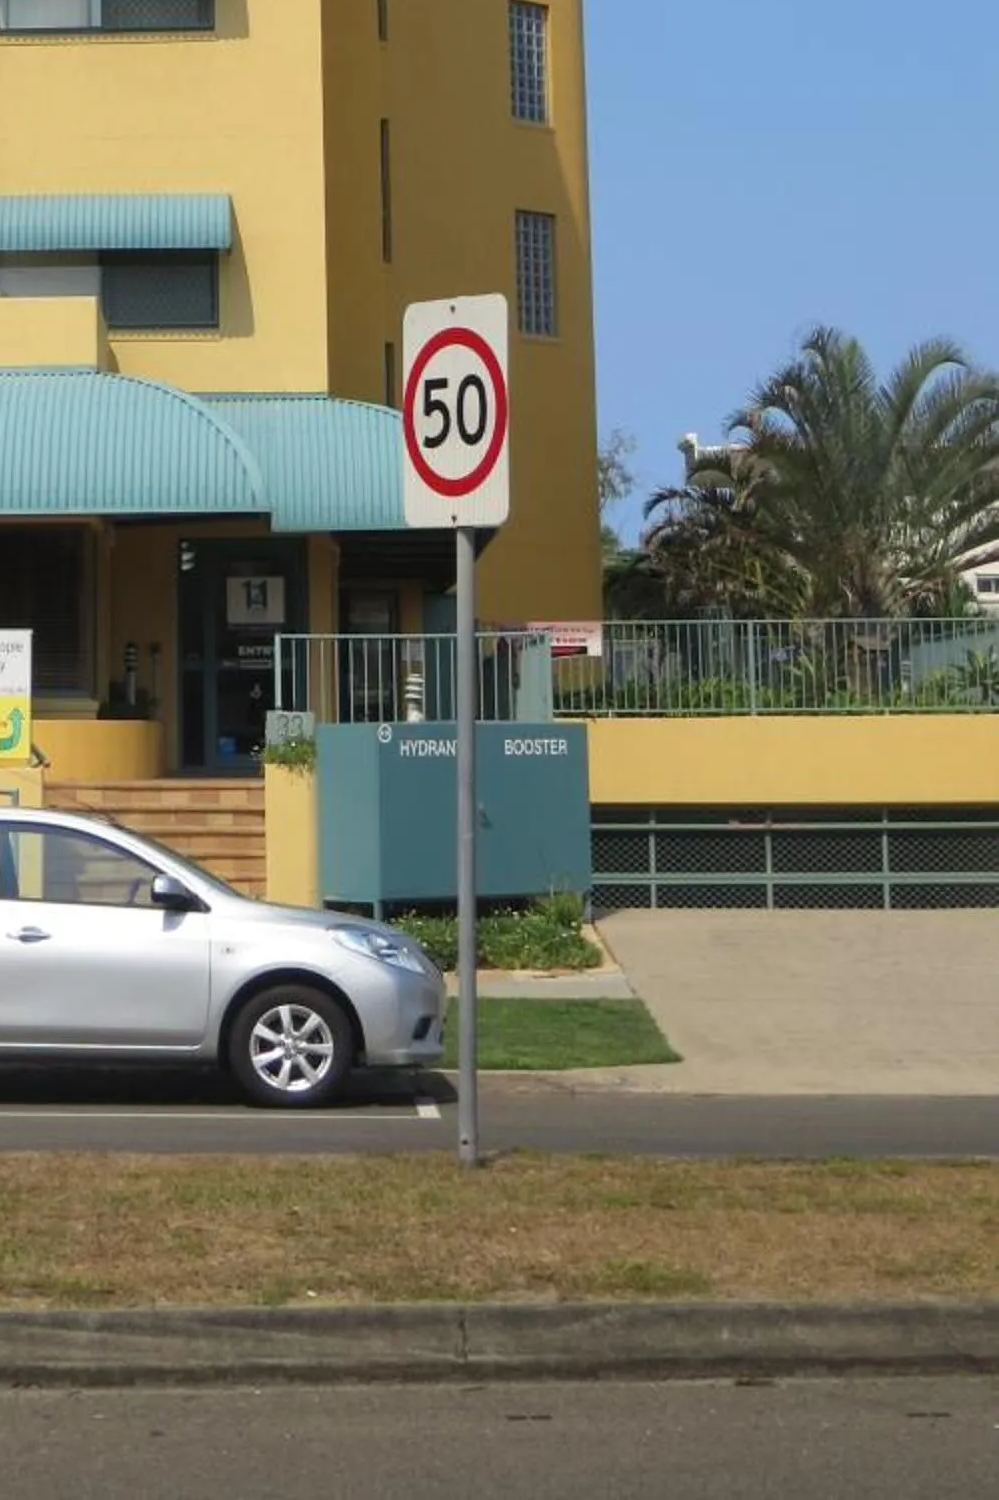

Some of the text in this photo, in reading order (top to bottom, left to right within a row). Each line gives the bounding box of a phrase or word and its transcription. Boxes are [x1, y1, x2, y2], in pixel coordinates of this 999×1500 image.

[423, 374, 487, 449] 50
[400, 738, 568, 757] HYDRAN BOOSTER
